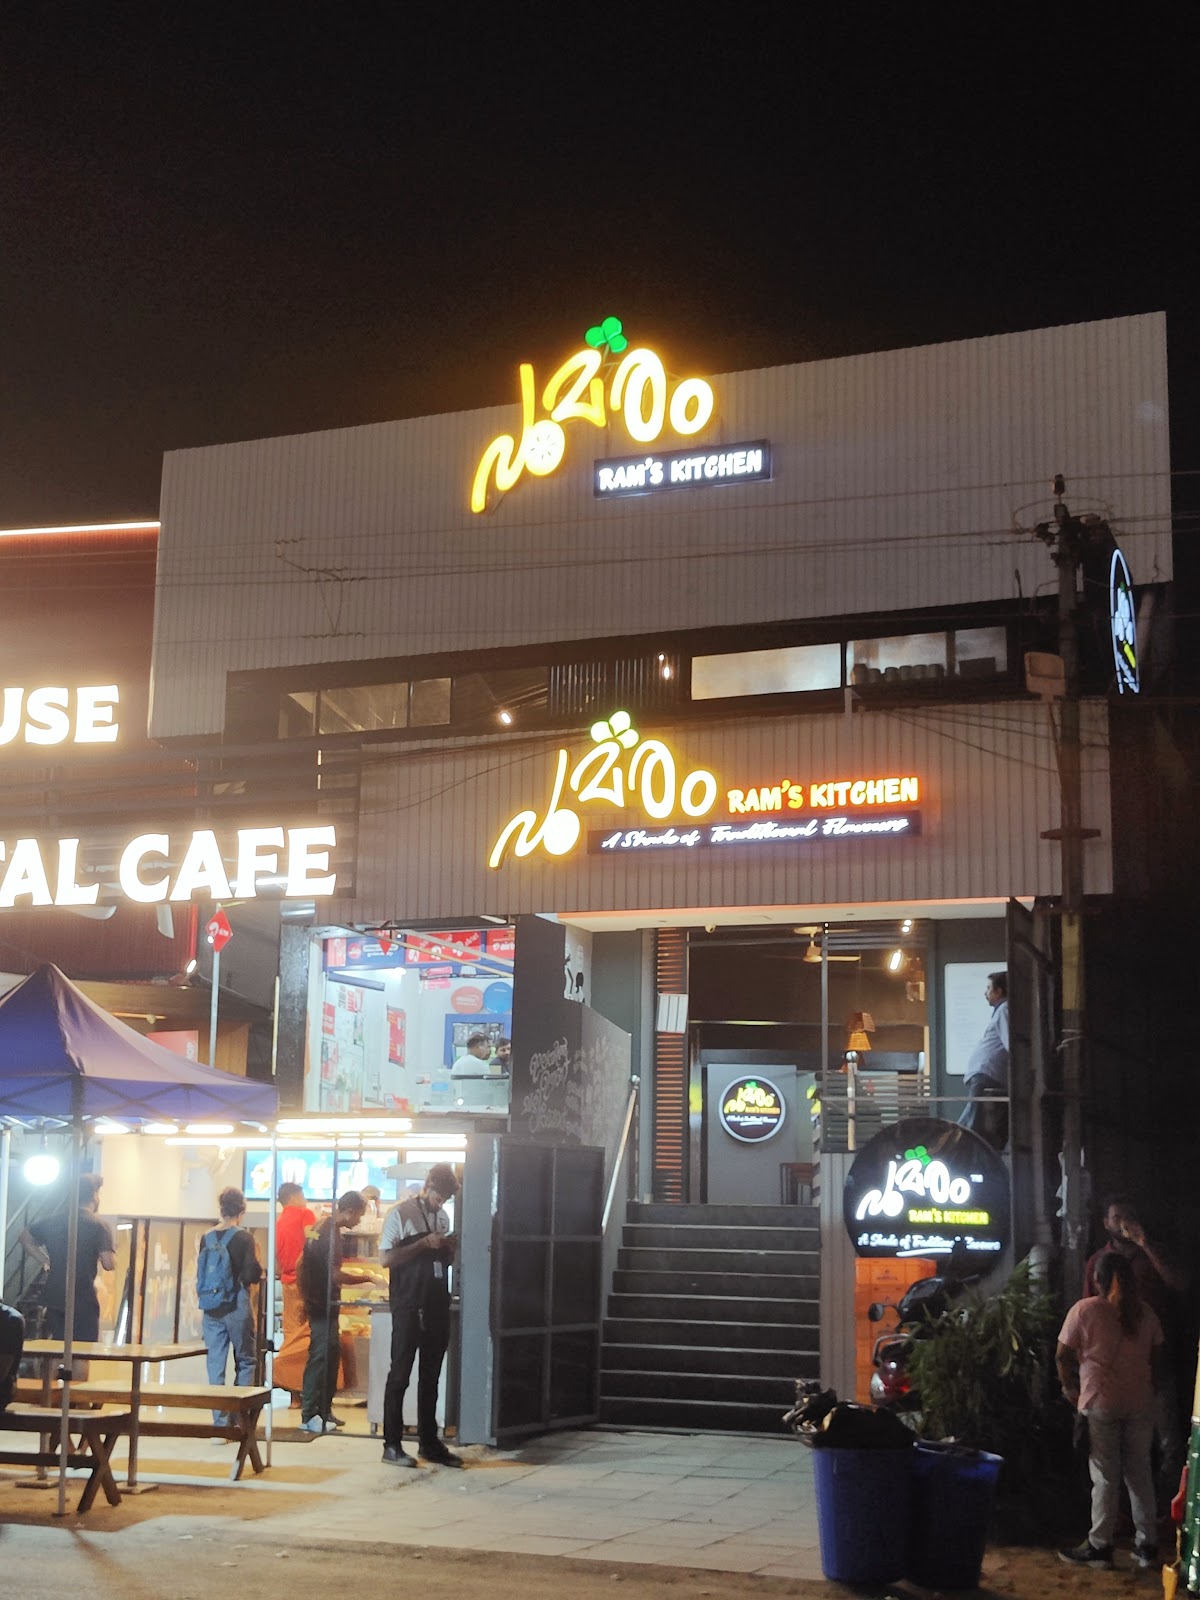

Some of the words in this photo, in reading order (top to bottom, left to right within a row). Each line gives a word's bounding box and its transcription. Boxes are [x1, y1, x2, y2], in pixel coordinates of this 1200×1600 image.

[598, 457, 663, 491] RAM'S
[670, 449, 762, 483] KITCHEN
[727, 779, 804, 814] RAM'S
[810, 777, 919, 808] KITCHEN
[0, 837, 100, 907] AL
[118, 825, 337, 903] CAFE
